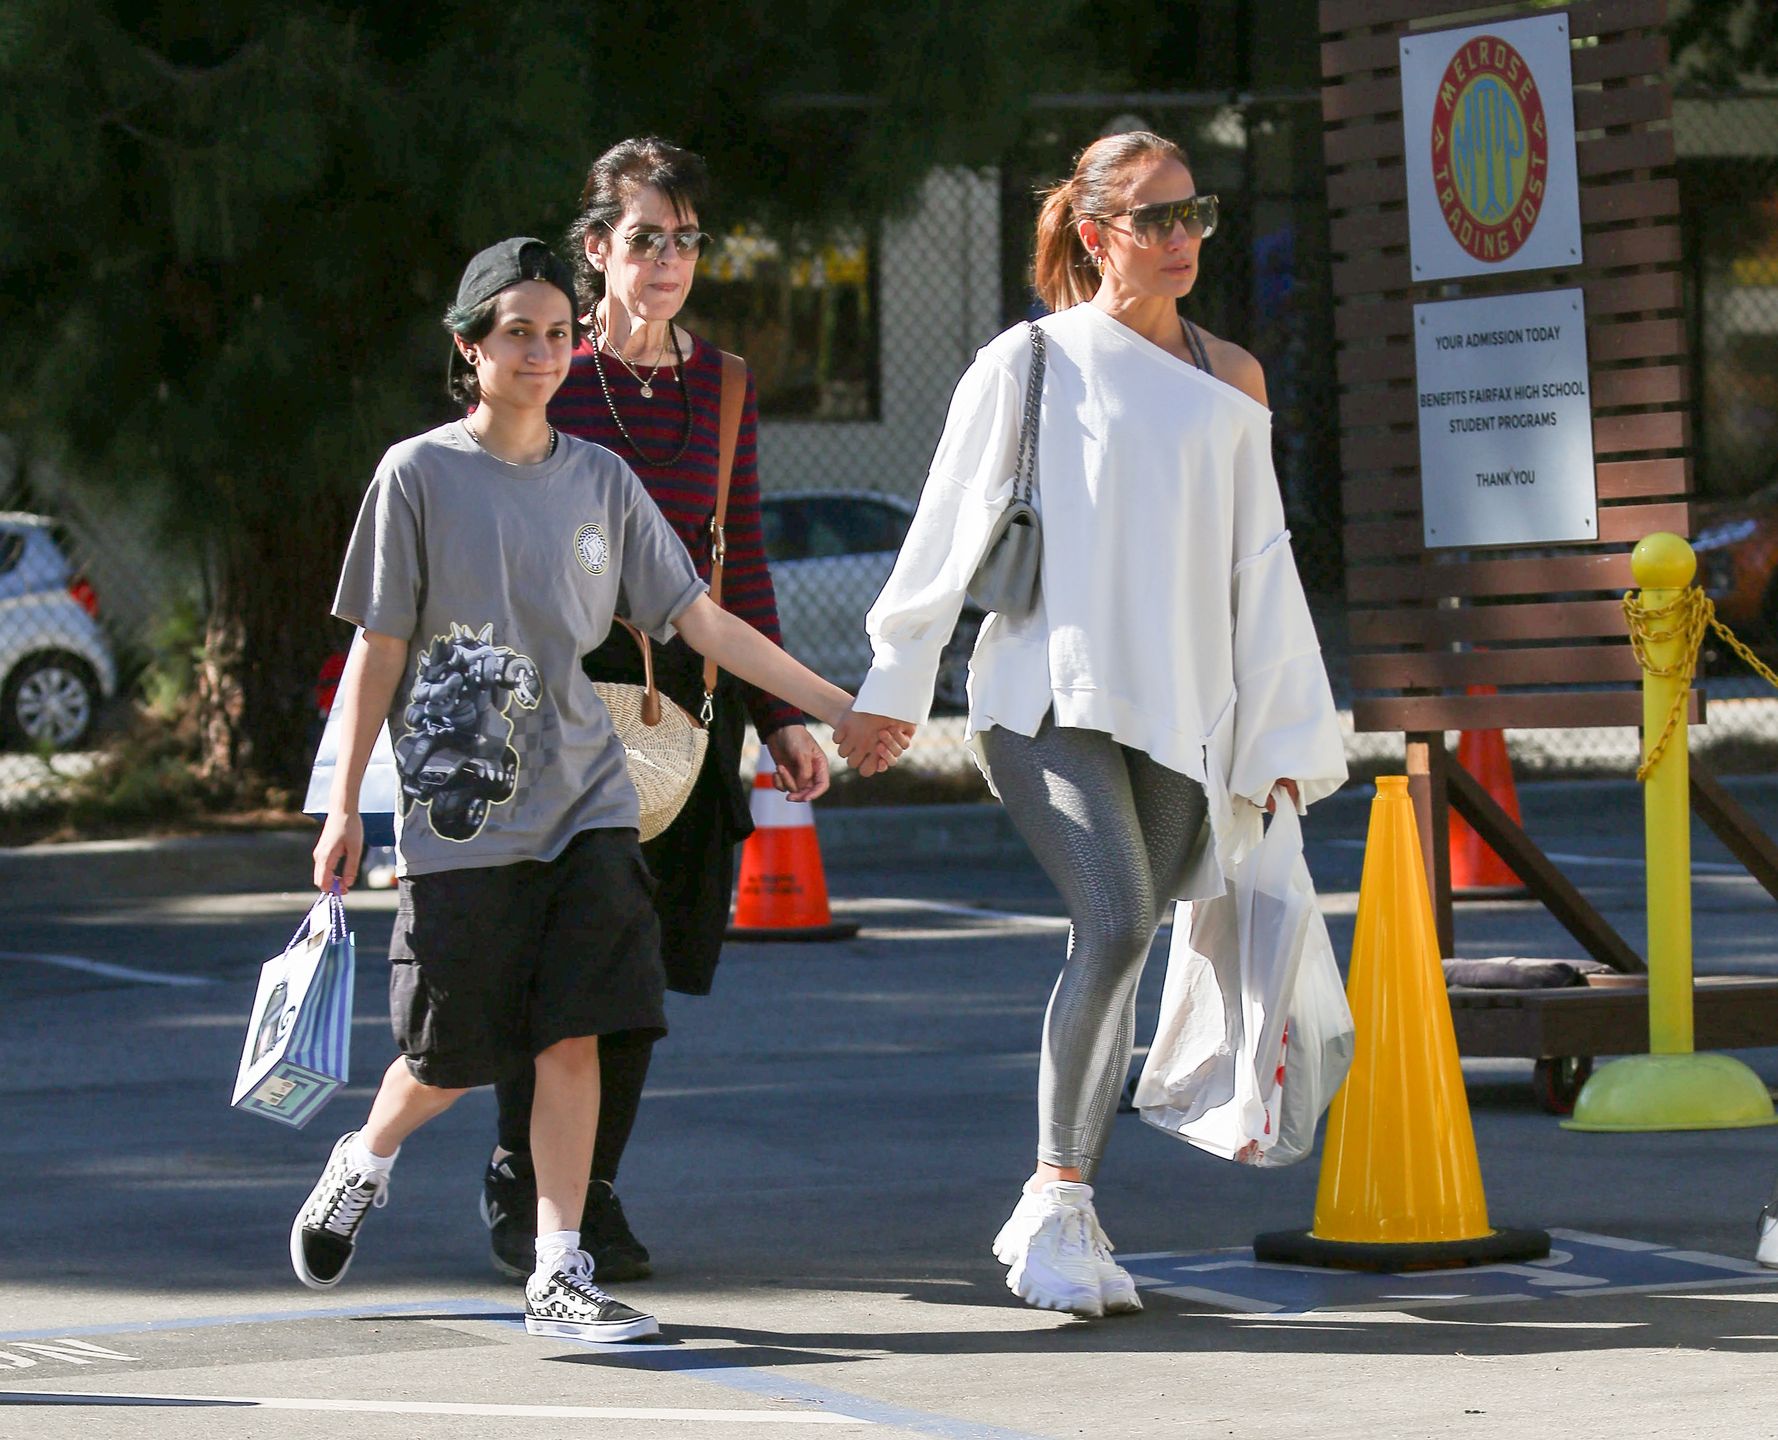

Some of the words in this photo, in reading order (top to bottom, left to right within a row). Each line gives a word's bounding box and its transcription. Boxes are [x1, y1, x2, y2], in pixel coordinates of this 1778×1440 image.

[1441, 41, 1534, 110] MELROSE
[1436, 164, 1509, 257] TRADING
[1512, 151, 1546, 241] POST
[1435, 334, 1463, 350] YOUR
[1466, 328, 1523, 348] ADMISSION
[1526, 326, 1561, 343] TODAY
[1420, 391, 1467, 408] BENEFITS
[1469, 386, 1512, 404] FAIRFAX
[1515, 384, 1540, 400] HIGH
[1542, 381, 1585, 398] SCHOOL
[1449, 416, 1497, 433] STUDENT
[1498, 412, 1557, 430] PROGRAMS
[1476, 471, 1511, 487] THANK
[1513, 470, 1535, 485] YOU
